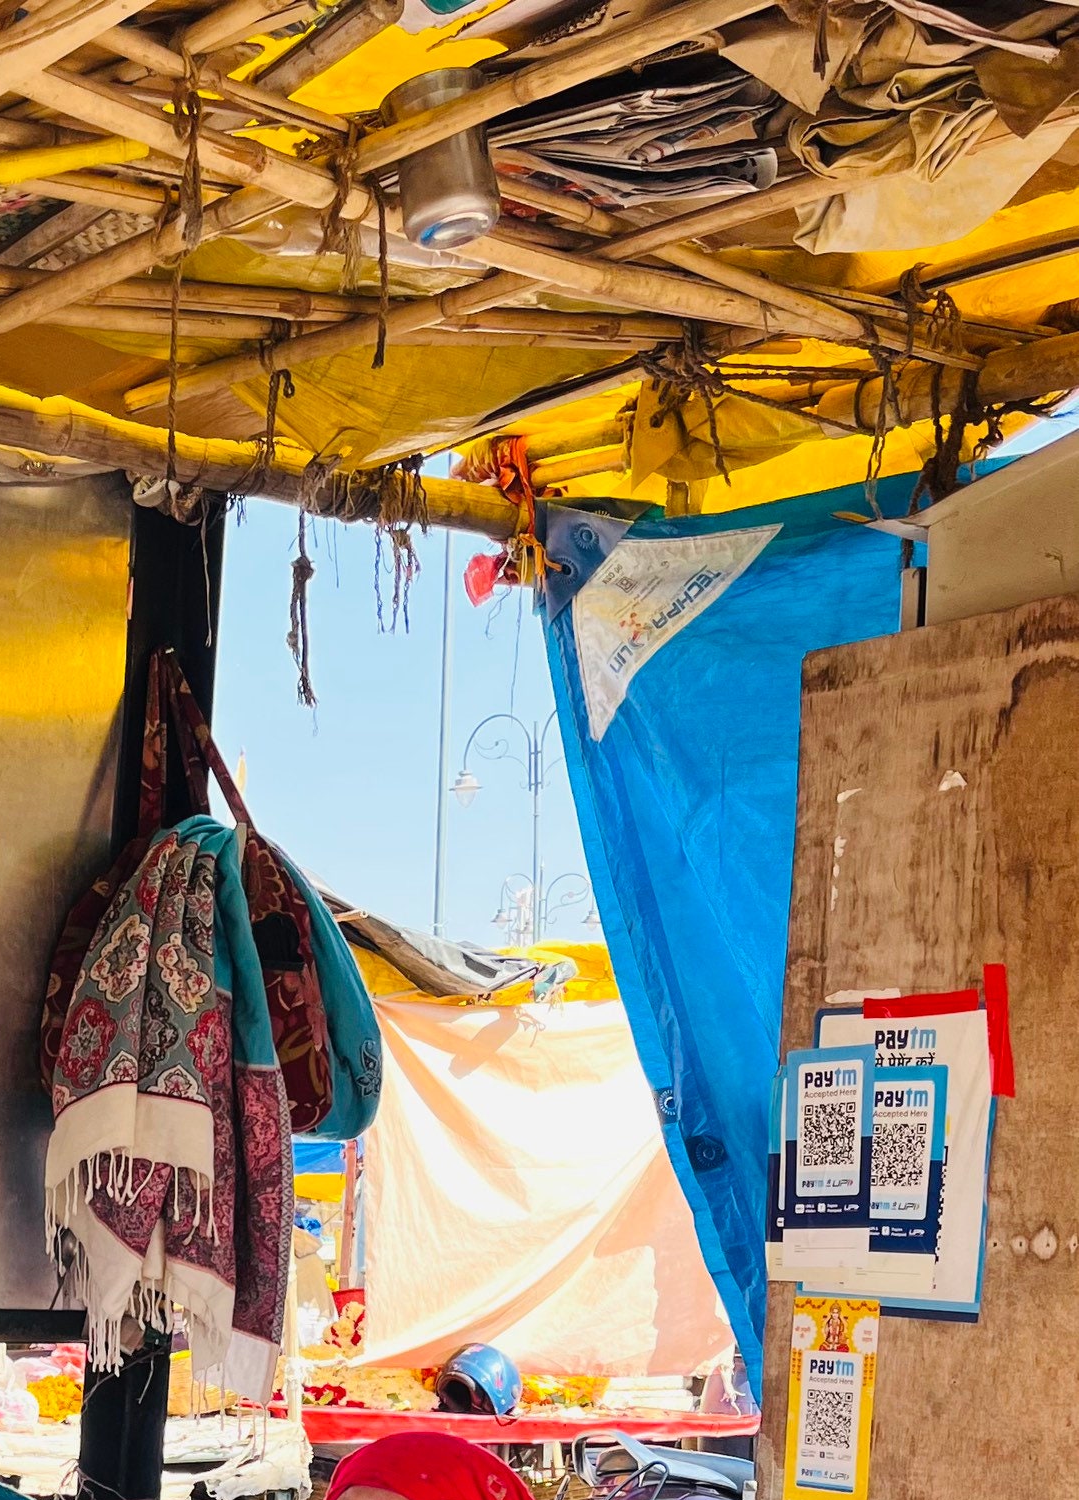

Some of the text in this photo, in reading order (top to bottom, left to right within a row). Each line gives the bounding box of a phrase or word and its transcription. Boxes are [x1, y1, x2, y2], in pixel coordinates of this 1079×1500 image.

[804, 1089, 857, 1099] Accepted Here
[873, 1109, 928, 1118] Accepted Here
[809, 1376, 854, 1385] Accepted Here
